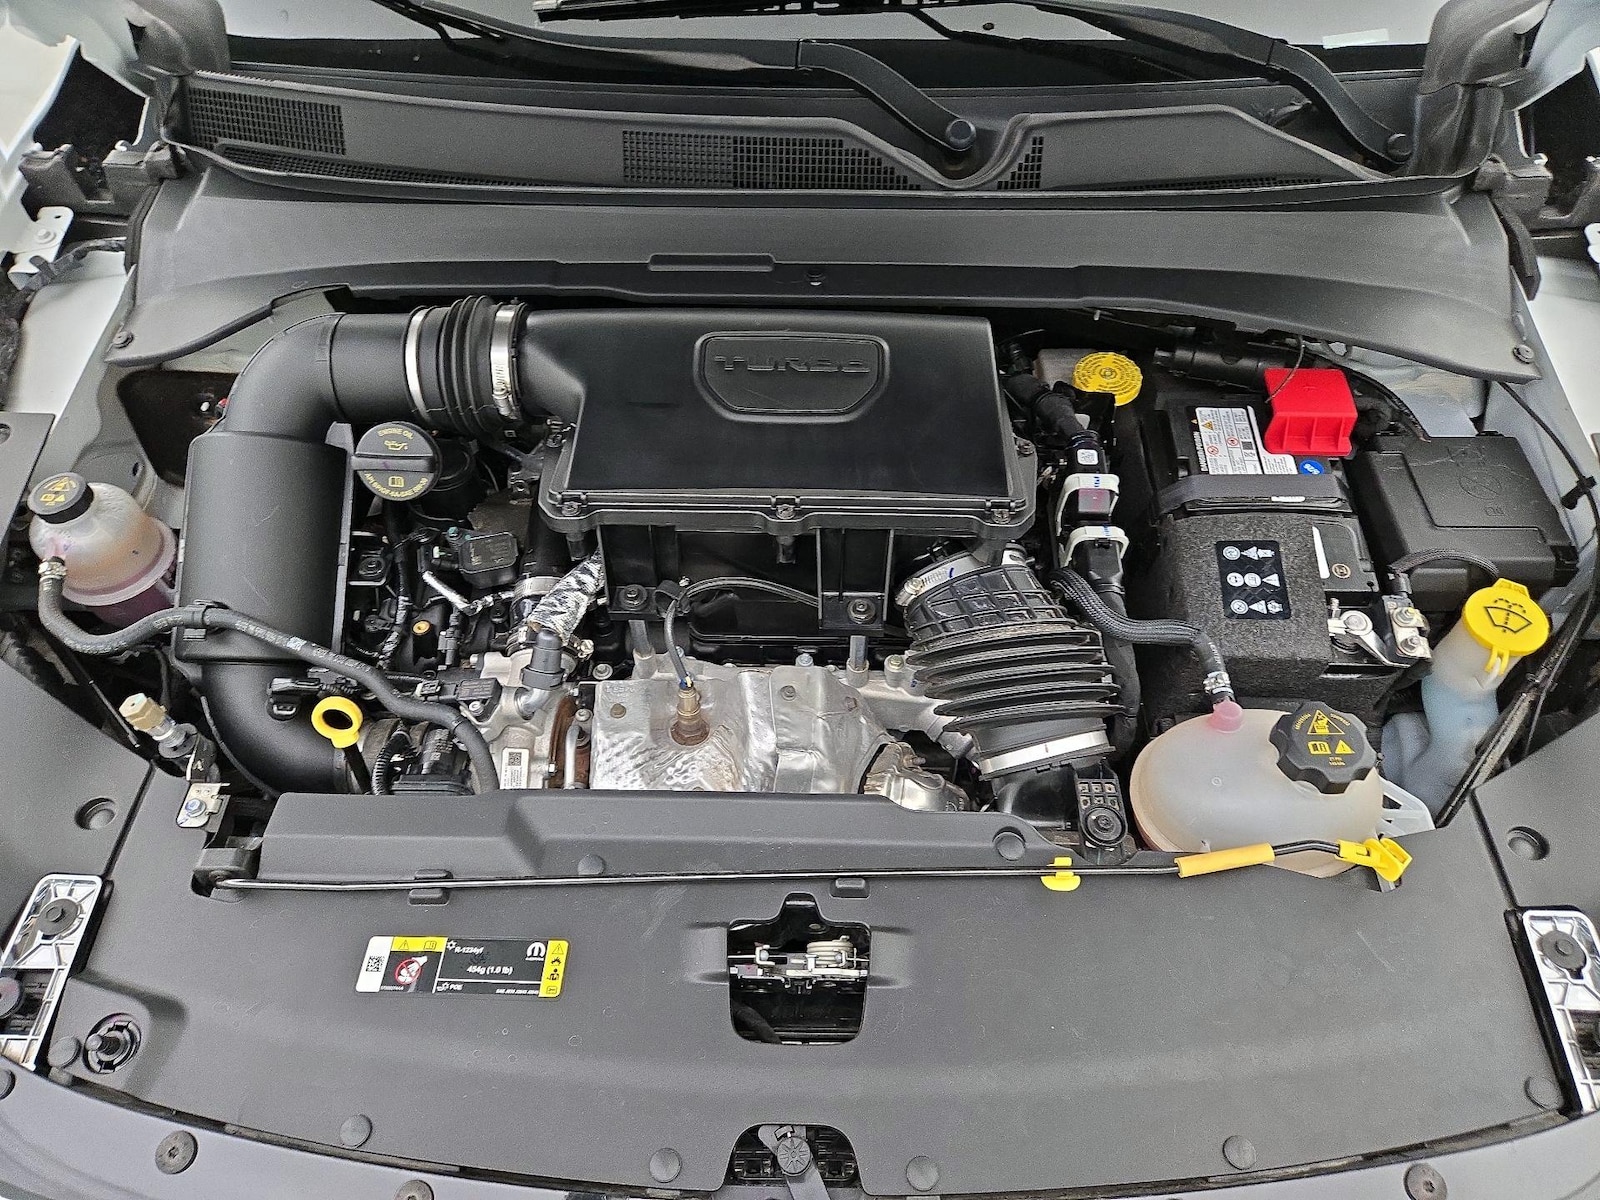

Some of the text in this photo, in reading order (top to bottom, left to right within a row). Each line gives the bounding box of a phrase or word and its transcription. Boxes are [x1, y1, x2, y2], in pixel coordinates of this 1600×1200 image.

[714, 355, 871, 373] TURBO
[378, 428, 414, 440] ENGINE OIL
[454, 946, 484, 955] R-1234yf
[466, 965, 486, 975] 454g
[502, 966, 513, 975] lb)
